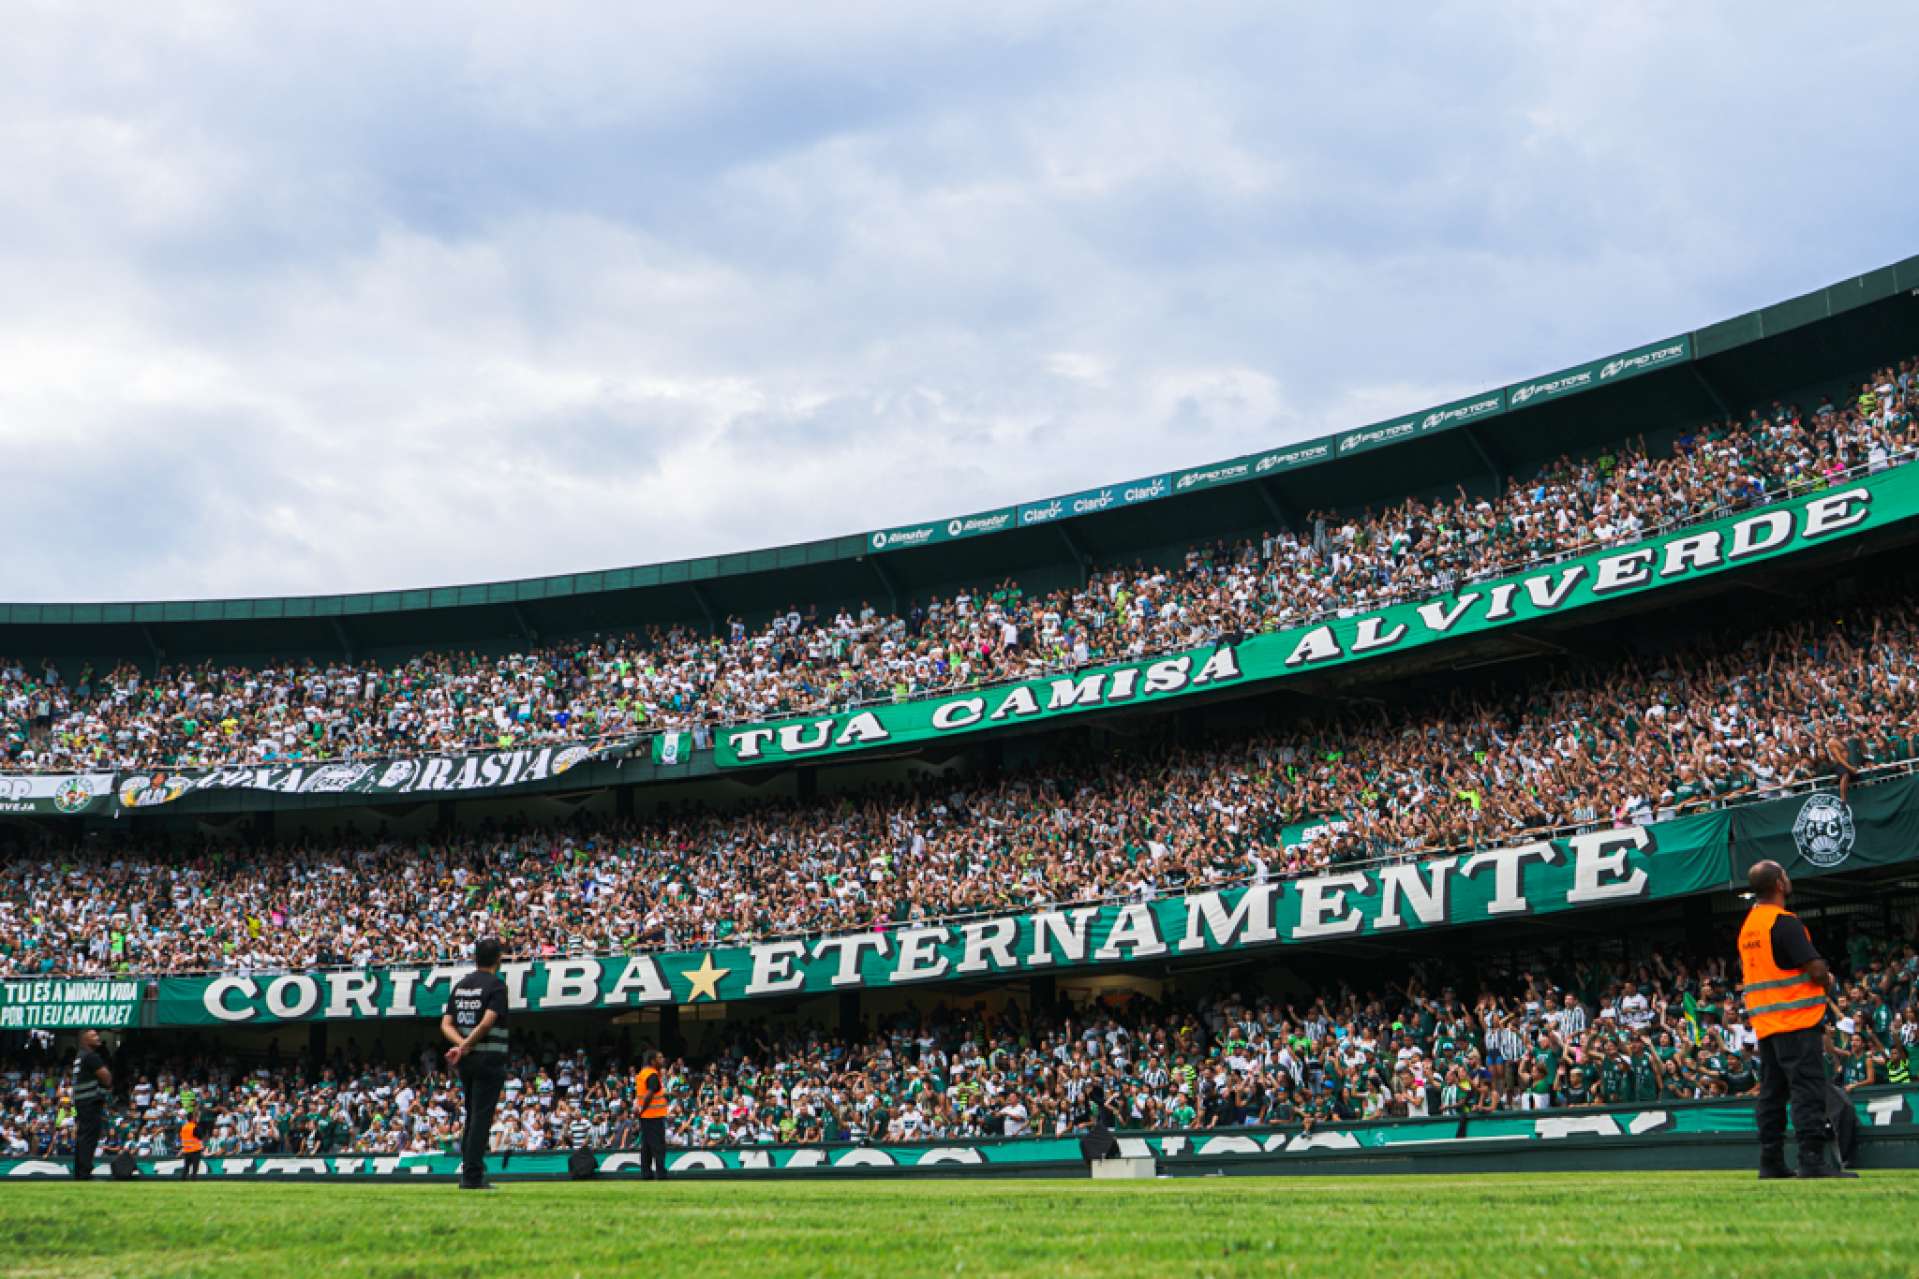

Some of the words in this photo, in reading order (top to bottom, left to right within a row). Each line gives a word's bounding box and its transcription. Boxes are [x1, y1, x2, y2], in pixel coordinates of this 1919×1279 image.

[1124, 484, 1160, 501] Claro
[1074, 494, 1109, 512] Claro
[1024, 505, 1058, 522] Claro
[729, 711, 888, 758] TUA
[932, 644, 1240, 729] CAMISA
[1286, 488, 1873, 665] ALVIVERDE
[416, 748, 551, 790] RASTA
[744, 826, 1649, 994] ETERNAMENTE
[4, 984, 31, 1002] TU
[52, 983, 62, 1002] A
[65, 982, 107, 1002] MINHA
[26, 1005, 40, 1025] TI
[42, 1005, 62, 1025] EU
